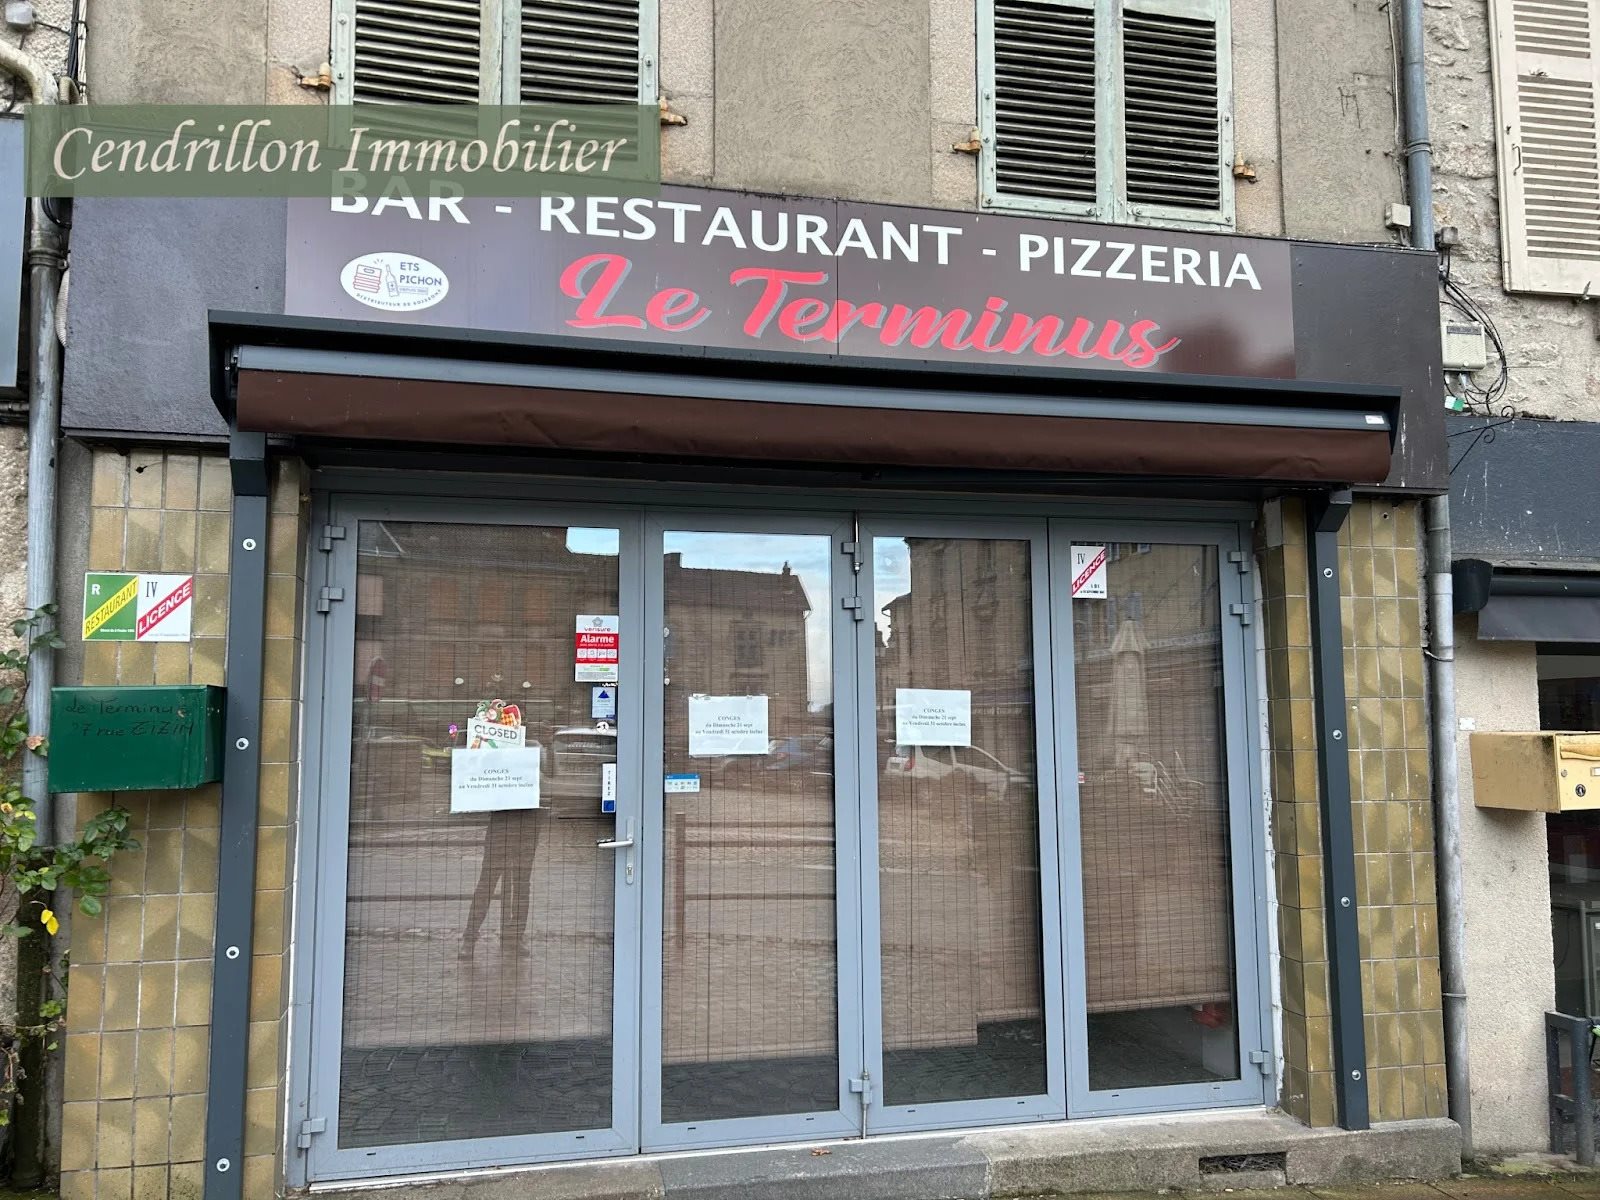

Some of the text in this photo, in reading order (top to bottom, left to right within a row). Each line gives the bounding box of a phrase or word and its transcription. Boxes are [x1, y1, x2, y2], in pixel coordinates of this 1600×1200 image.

[330, 170, 471, 225] BAR
[539, 190, 963, 265] RESTAURANT
[1019, 233, 1262, 291] PIZZERIA
[400, 261, 420, 272] ETS
[399, 274, 442, 286] PICHON
[559, 253, 1182, 370] Le Terminus
[1077, 553, 1085, 565] IV
[1072, 551, 1105, 592] LICENCE
[91, 583, 101, 596] R
[145, 581, 158, 598] IV
[85, 580, 137, 635] RESTAURANT
[138, 582, 191, 632] LICENCE
[580, 634, 615, 644] Alarme
[65, 694, 87, 714] Le
[97, 726, 126, 737] rue
[474, 724, 518, 740] CLOSED
